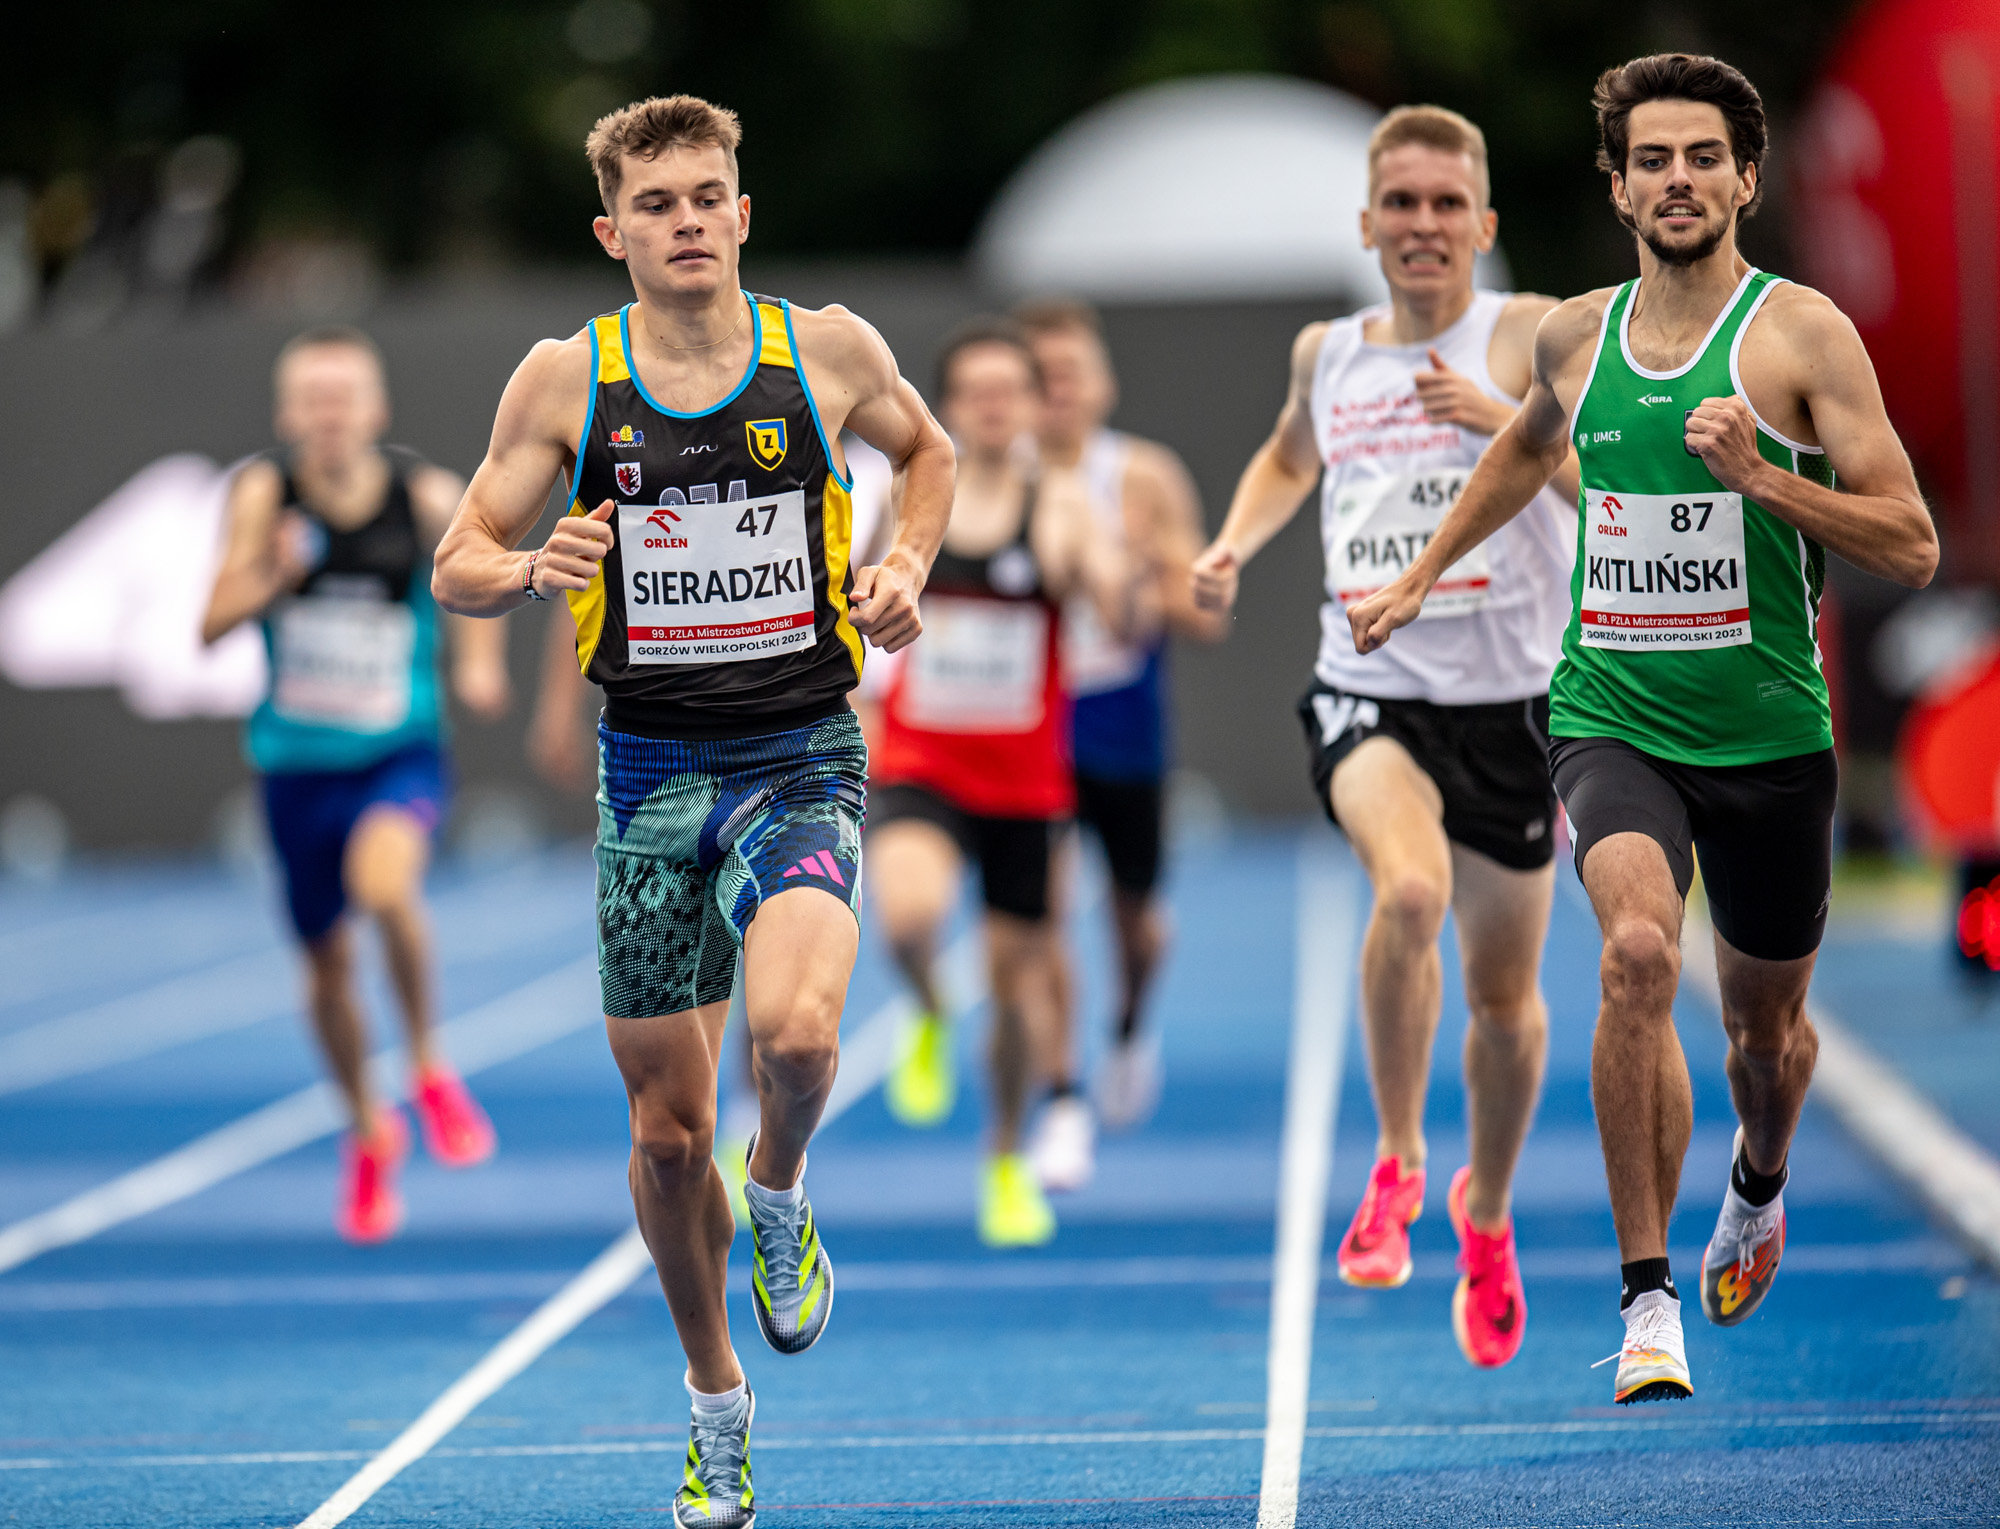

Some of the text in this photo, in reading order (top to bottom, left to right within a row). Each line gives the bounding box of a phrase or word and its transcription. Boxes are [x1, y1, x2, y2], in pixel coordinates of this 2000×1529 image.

[762, 434, 773, 449] Z
[1593, 430, 1621, 443] UMCS
[735, 503, 778, 538] 47
[1670, 502, 1714, 533] 87
[1597, 524, 1628, 537] ORLEN
[644, 538, 688, 548] ORLEN
[632, 557, 806, 605] SIERADZKI
[1588, 552, 1738, 593] KITLIŃSKI
[651, 617, 793, 639] 99. PZLA Mistrzostwa Polski
[1597, 613, 1727, 627] 99. PZLA Mistrzostwa Polski
[637, 631, 807, 656] GORZÓW WIELKOPOLSKI 2023
[1587, 627, 1743, 643] GORZÓW WIELKOPOLSKI 2023
